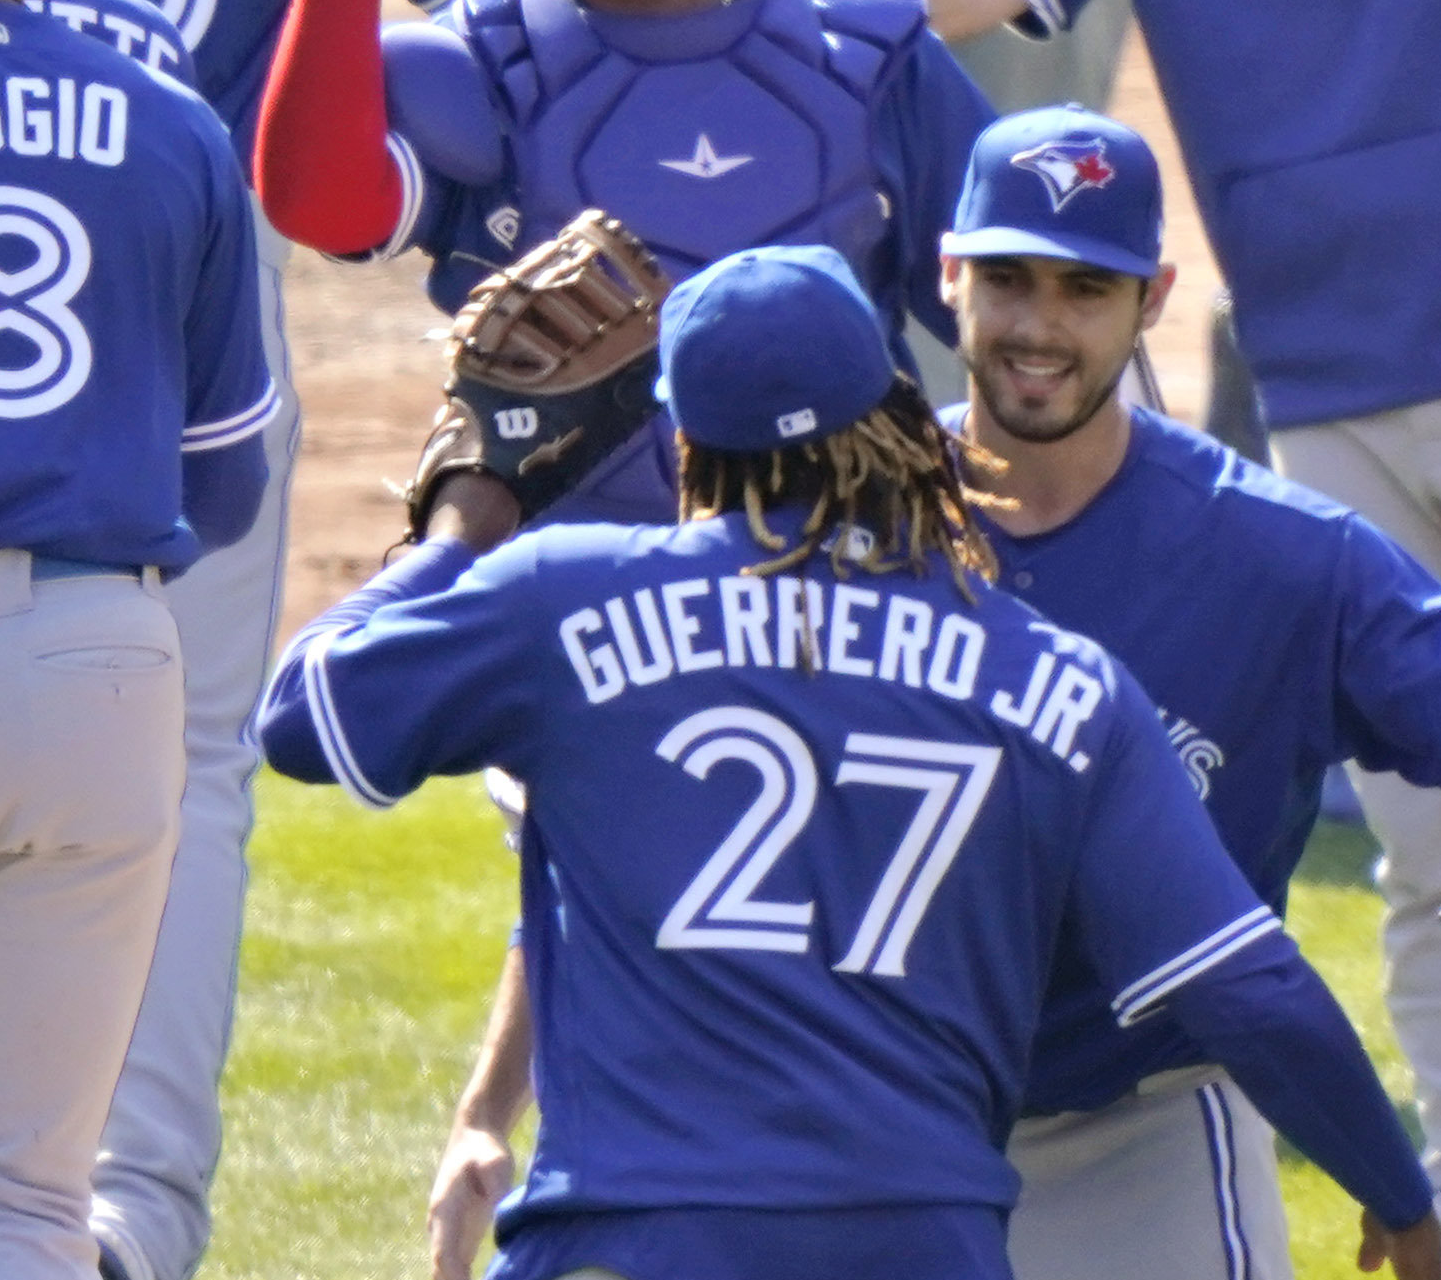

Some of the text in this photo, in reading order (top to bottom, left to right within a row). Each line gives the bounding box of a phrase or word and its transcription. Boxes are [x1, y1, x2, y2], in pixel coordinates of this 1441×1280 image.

[558, 575, 1105, 774] GUERRERO JR.
[654, 705, 1004, 978] 27
